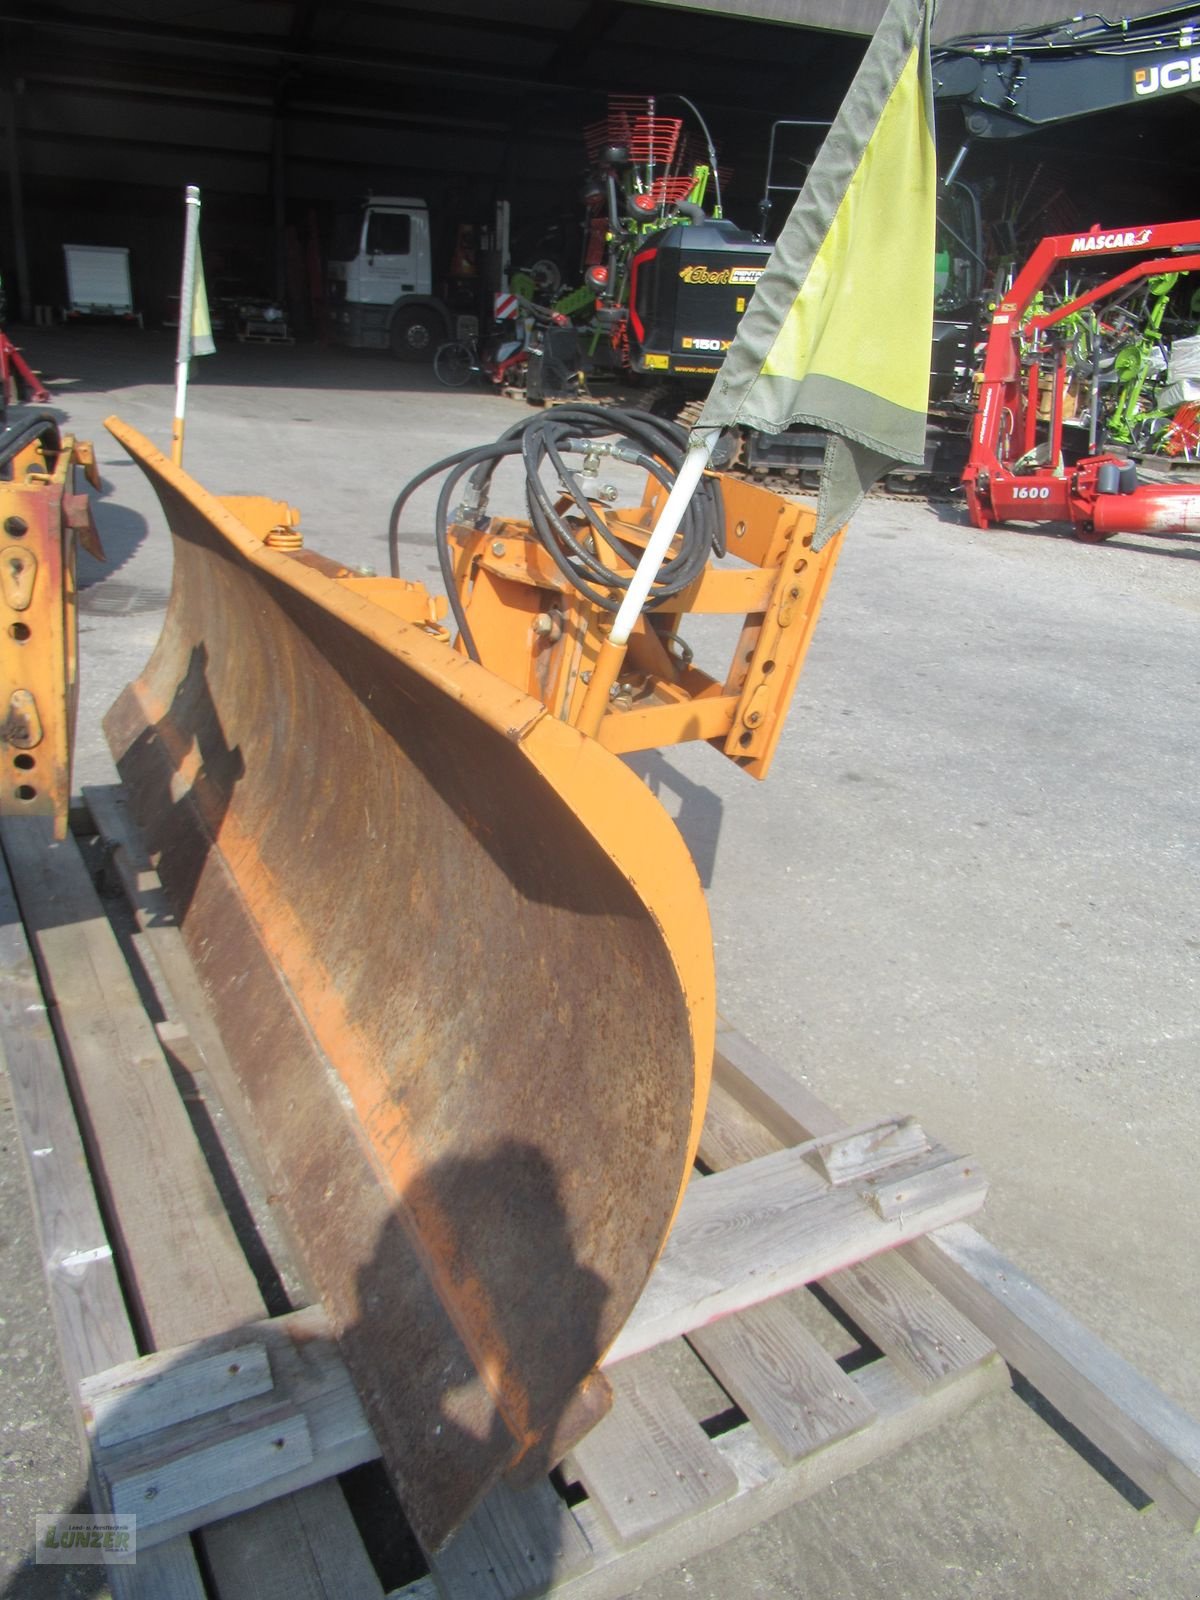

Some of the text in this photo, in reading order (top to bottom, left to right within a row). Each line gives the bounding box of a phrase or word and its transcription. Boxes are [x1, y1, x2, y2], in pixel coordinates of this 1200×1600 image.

[1071, 232, 1136, 253] MASCAR
[690, 266, 730, 285] Ebert
[1012, 487, 1050, 499] 1600
